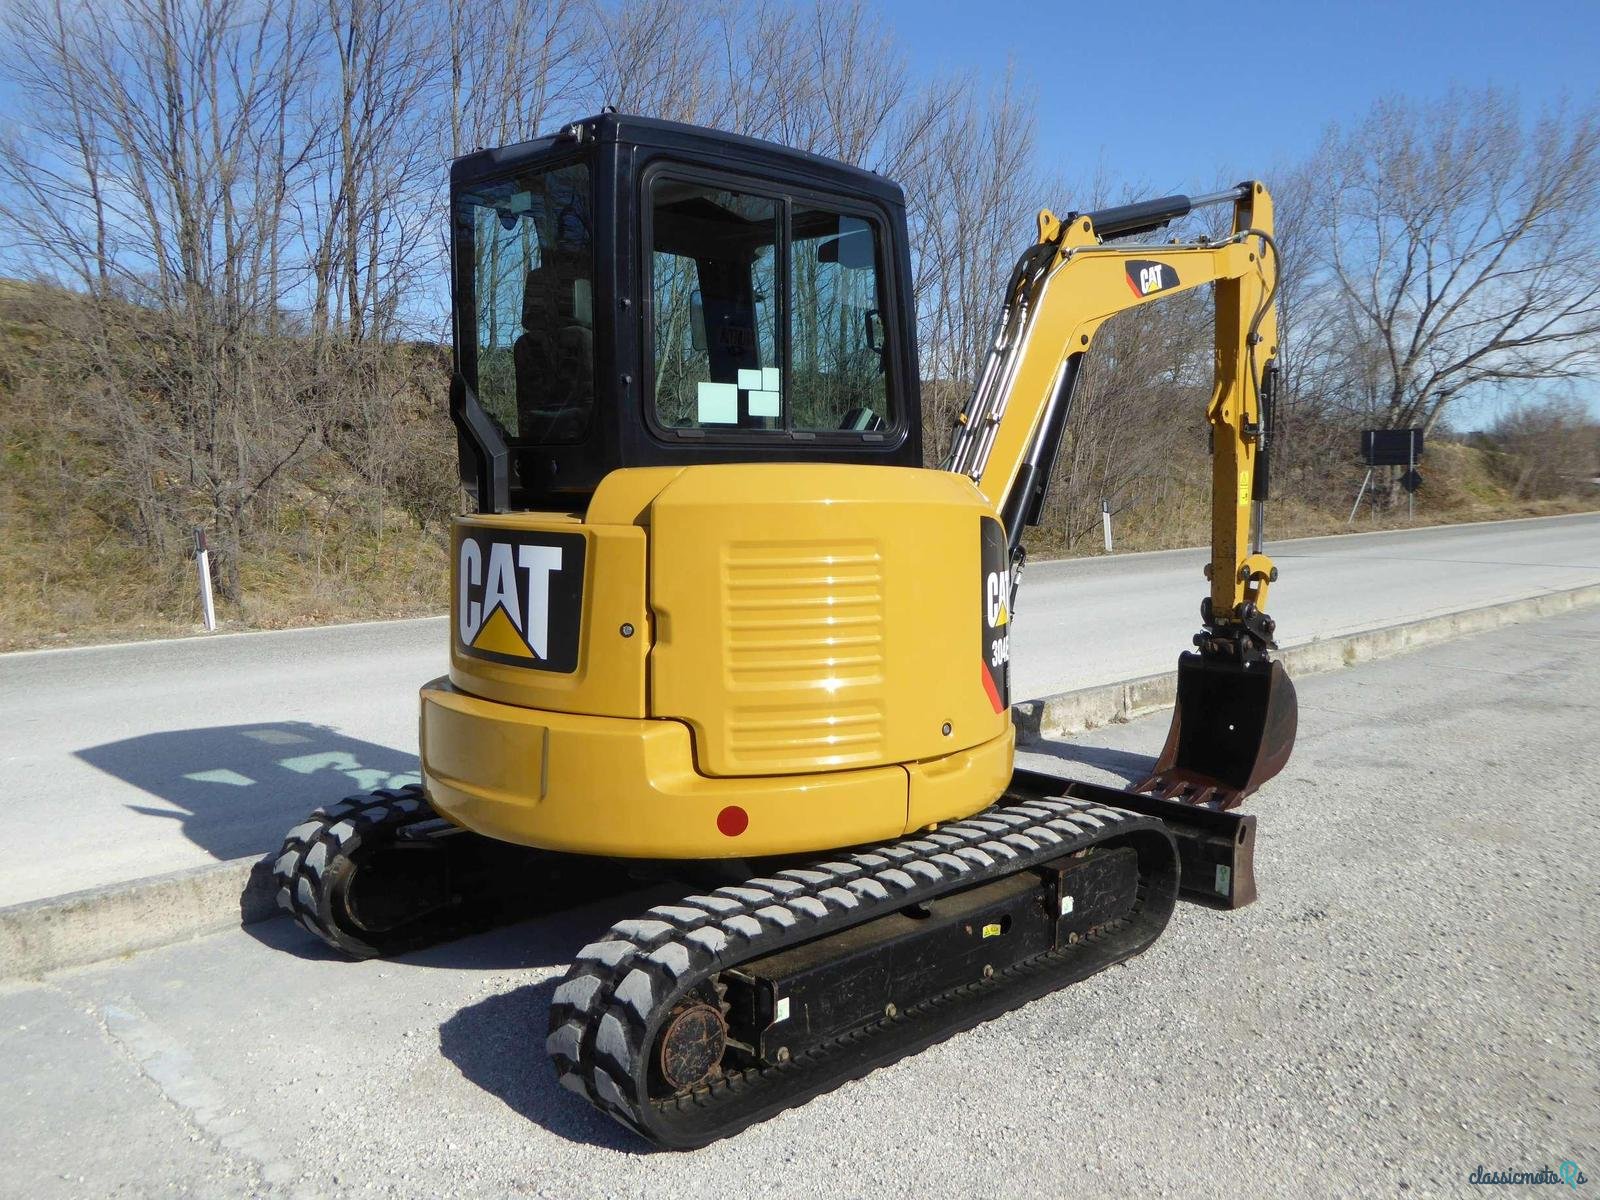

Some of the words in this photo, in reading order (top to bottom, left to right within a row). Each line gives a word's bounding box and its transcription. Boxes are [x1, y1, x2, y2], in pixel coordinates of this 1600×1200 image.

[1140, 264, 1162, 294] CAT
[459, 537, 563, 660] CAT
[987, 570, 1009, 628] CAT
